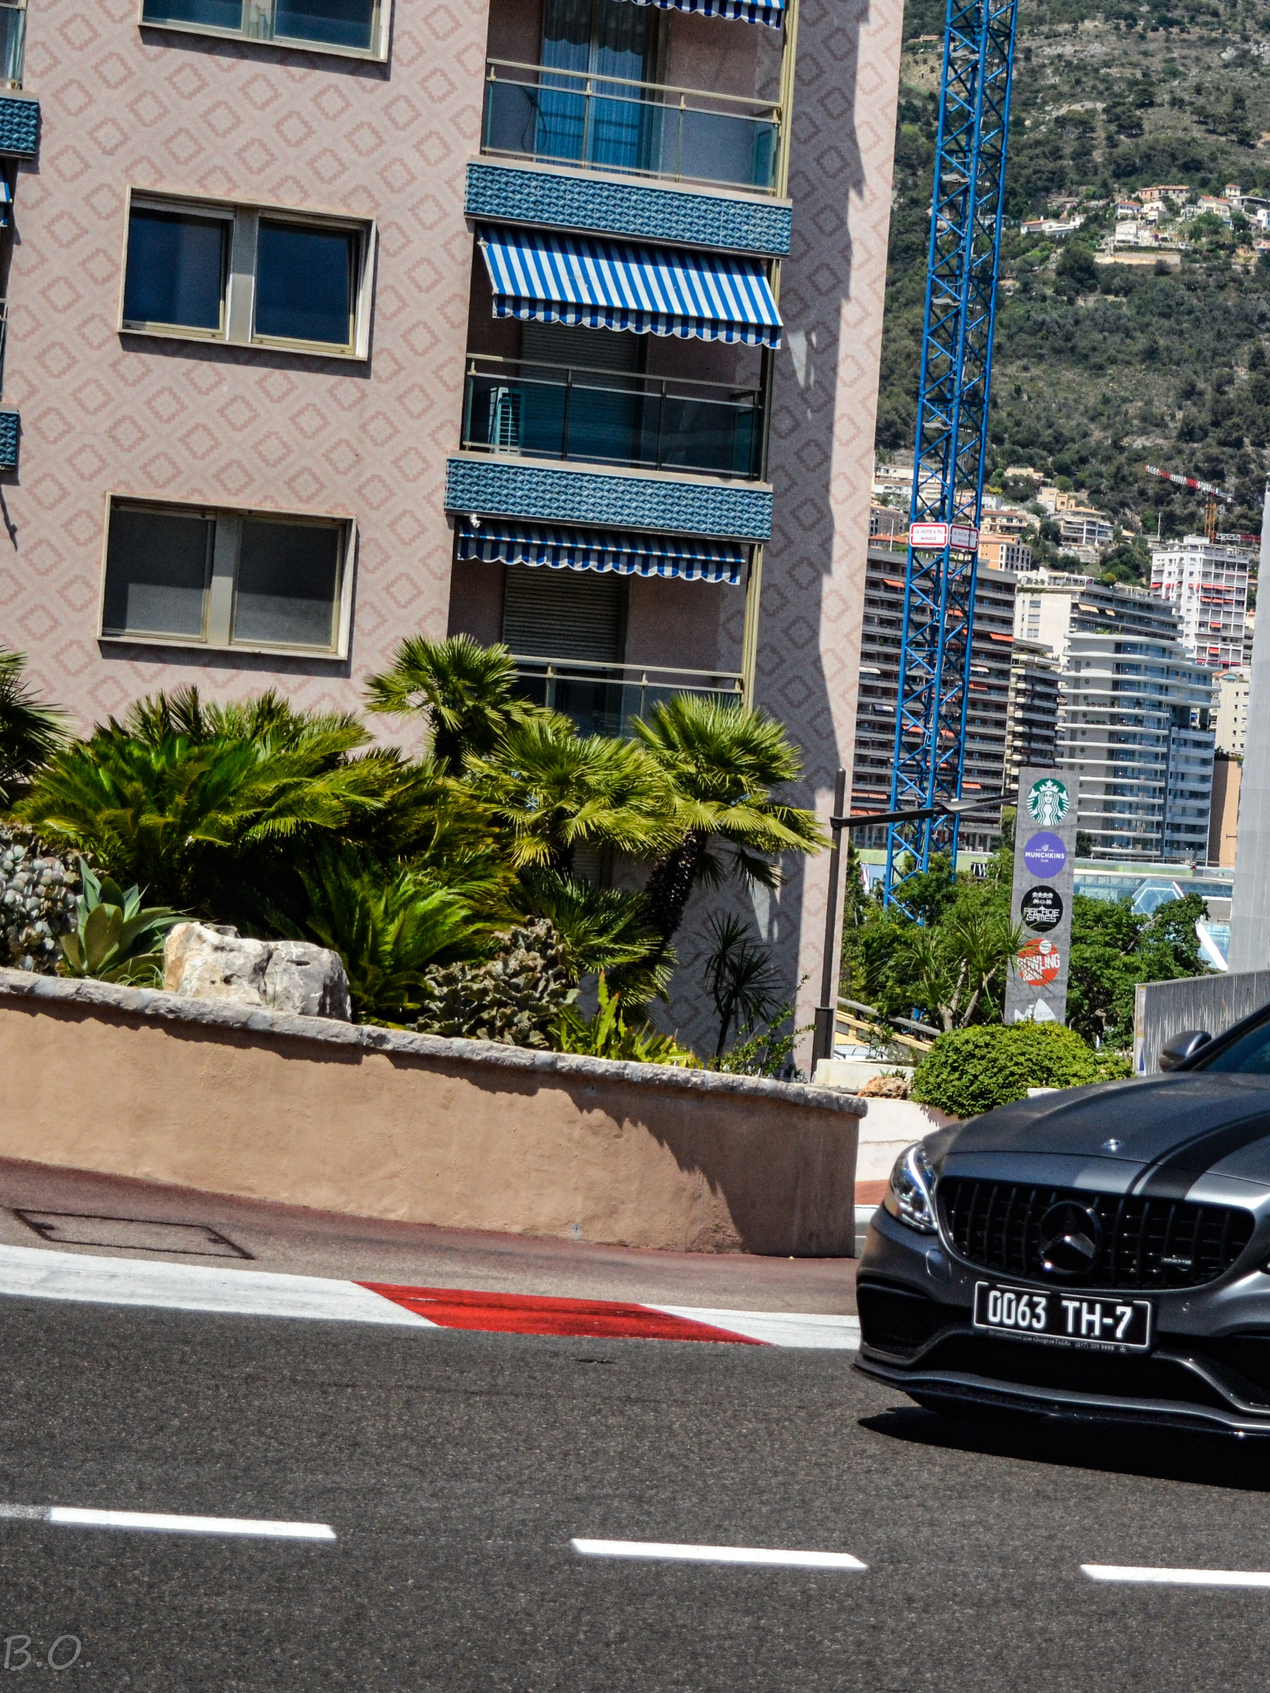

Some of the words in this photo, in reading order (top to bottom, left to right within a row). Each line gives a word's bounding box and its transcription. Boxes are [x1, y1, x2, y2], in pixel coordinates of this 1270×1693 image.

[1025, 851, 1065, 859] MUNCHKINS
[1024, 907, 1060, 917] ARCADE
[1027, 914, 1057, 922] GAMES
[988, 1290, 1046, 1329] 0063
[1062, 1300, 1133, 1338] TH-7
